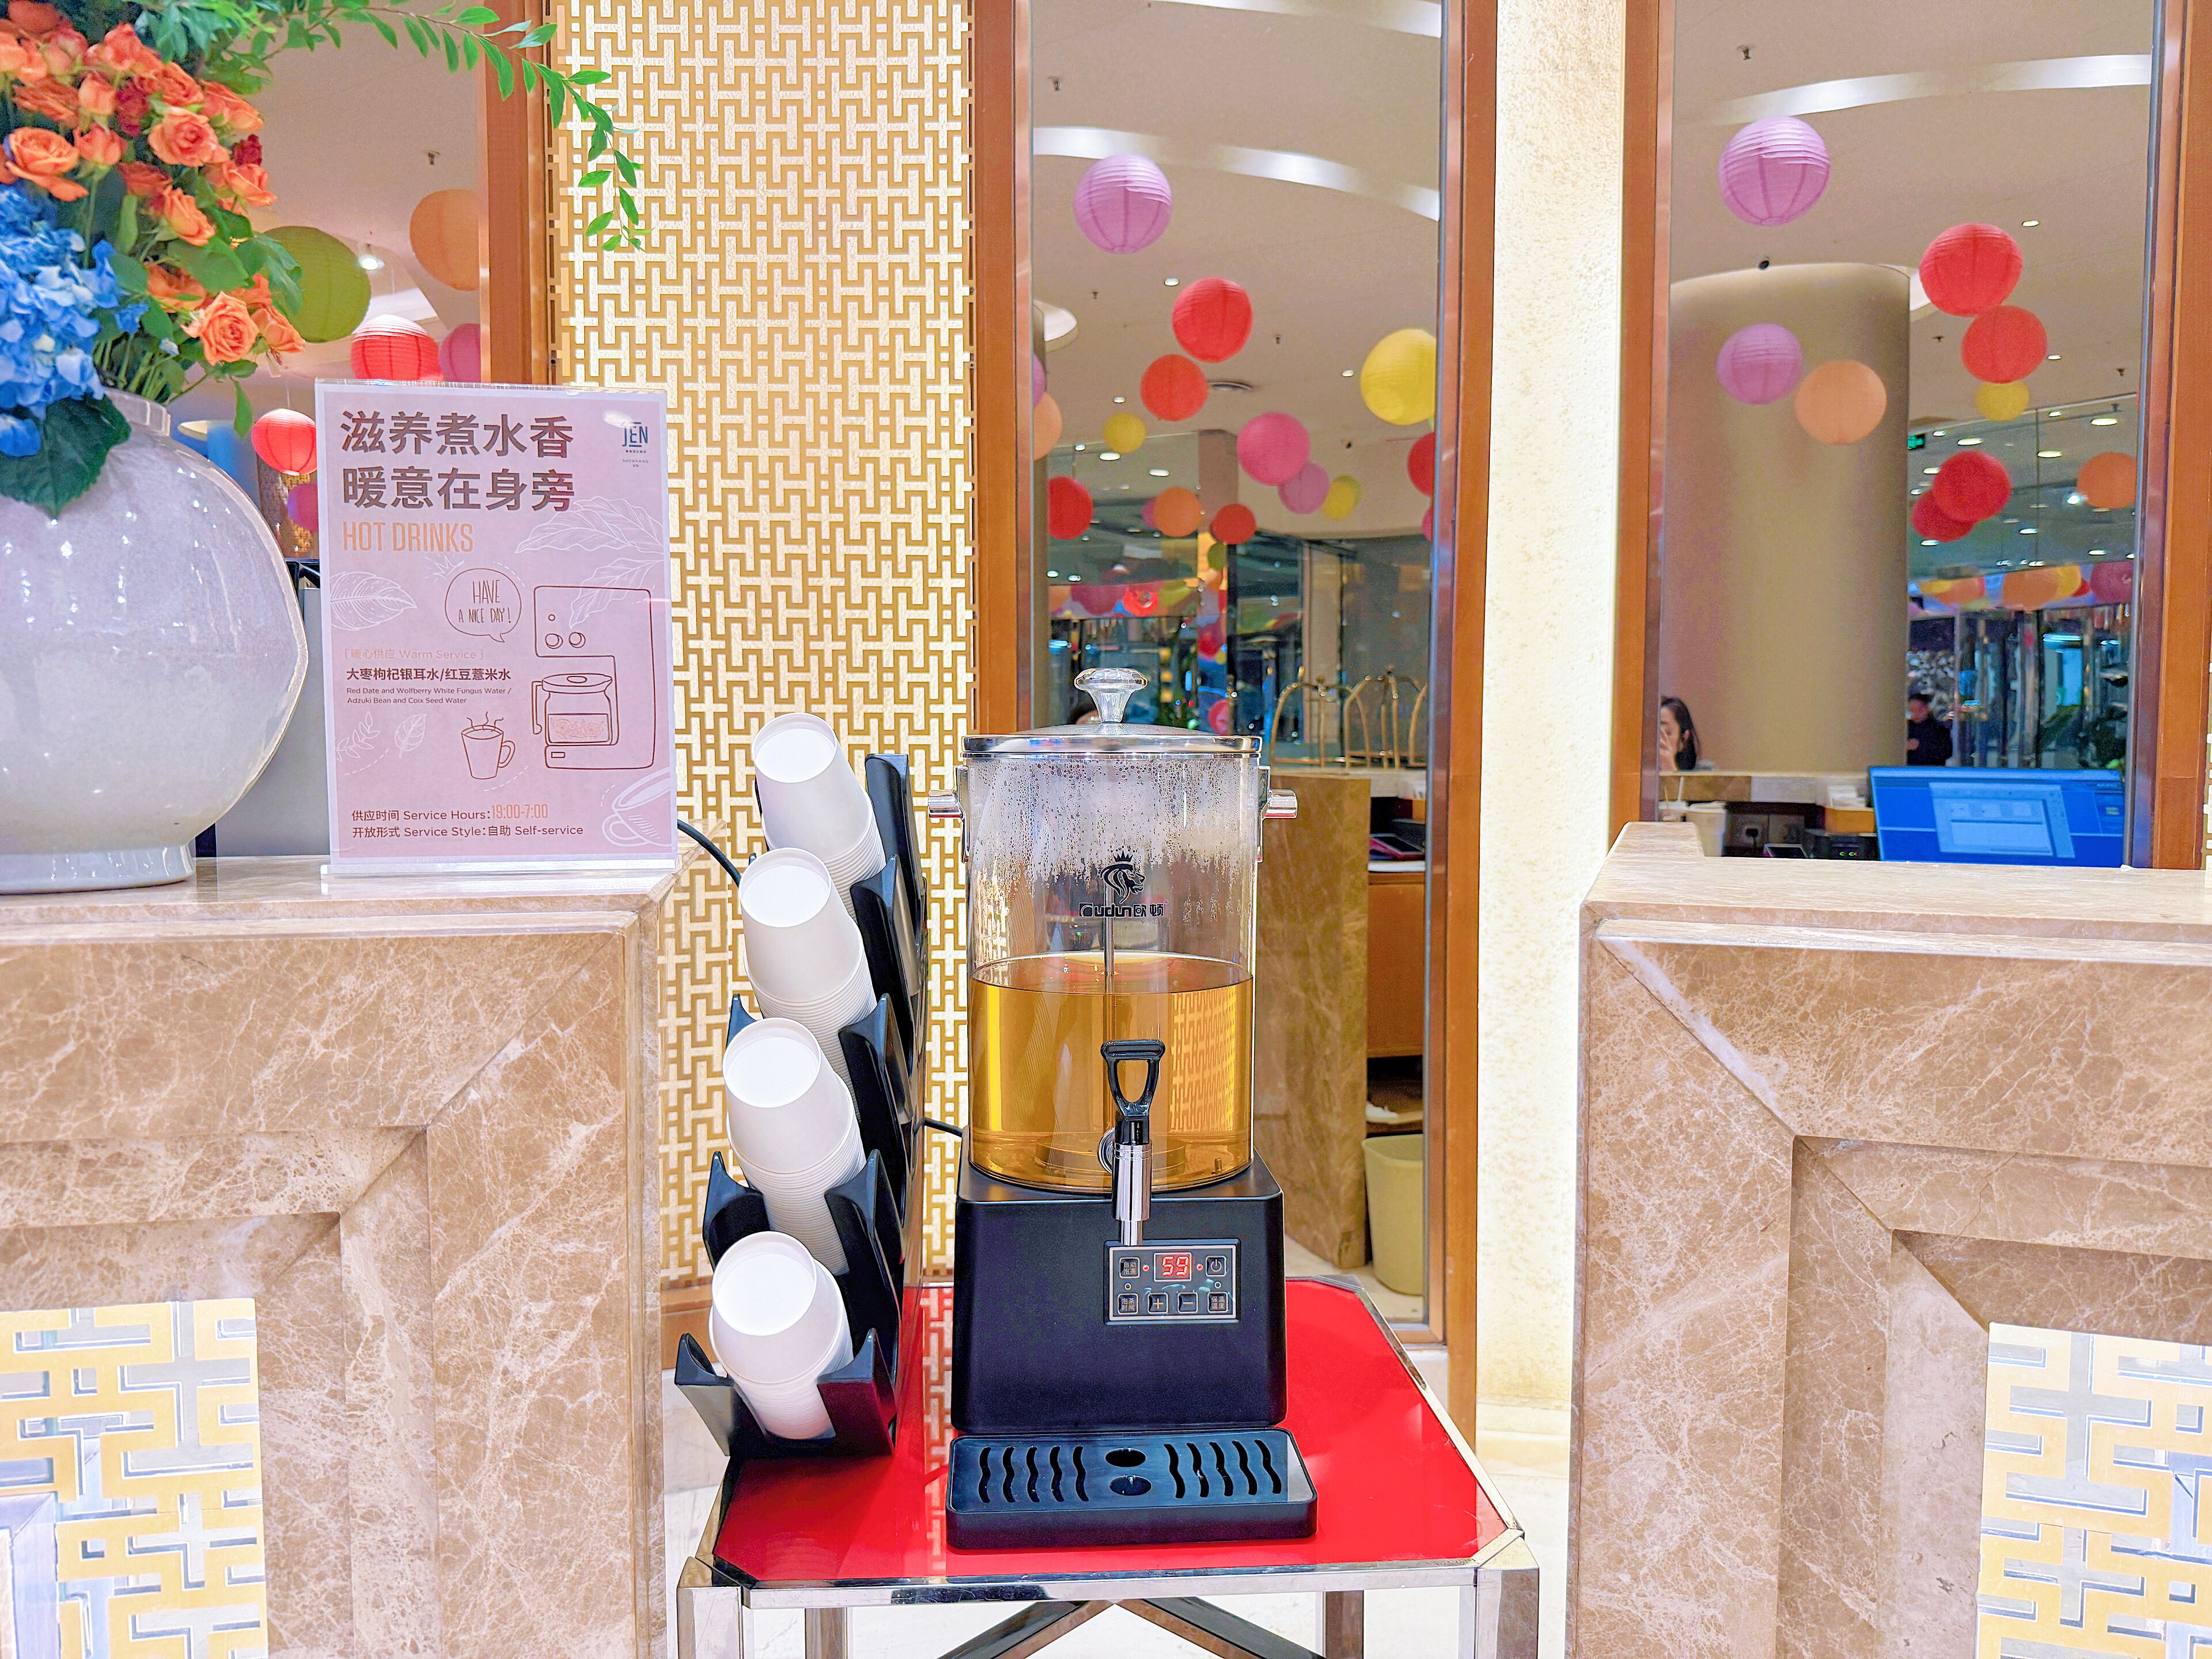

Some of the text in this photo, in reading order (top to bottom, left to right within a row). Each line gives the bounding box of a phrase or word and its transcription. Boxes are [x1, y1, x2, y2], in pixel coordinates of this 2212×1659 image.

[341, 410, 573, 458] 滋养煮水香
[343, 466, 575, 512] 暖意在身旁
[343, 521, 473, 552] HOT DRINKS
[472, 579, 500, 604] HAVE
[459, 609, 464, 623] A
[469, 608, 484, 623] NICE
[399, 650, 433, 659] Warm
[436, 649, 476, 659] Service
[351, 810, 399, 821] 供应时间
[403, 810, 447, 820] Service
[352, 827, 400, 838] 开放形式
[404, 827, 448, 837] Service
[515, 825, 584, 836] Self-service
[1162, 1255, 1189, 1277] 59
